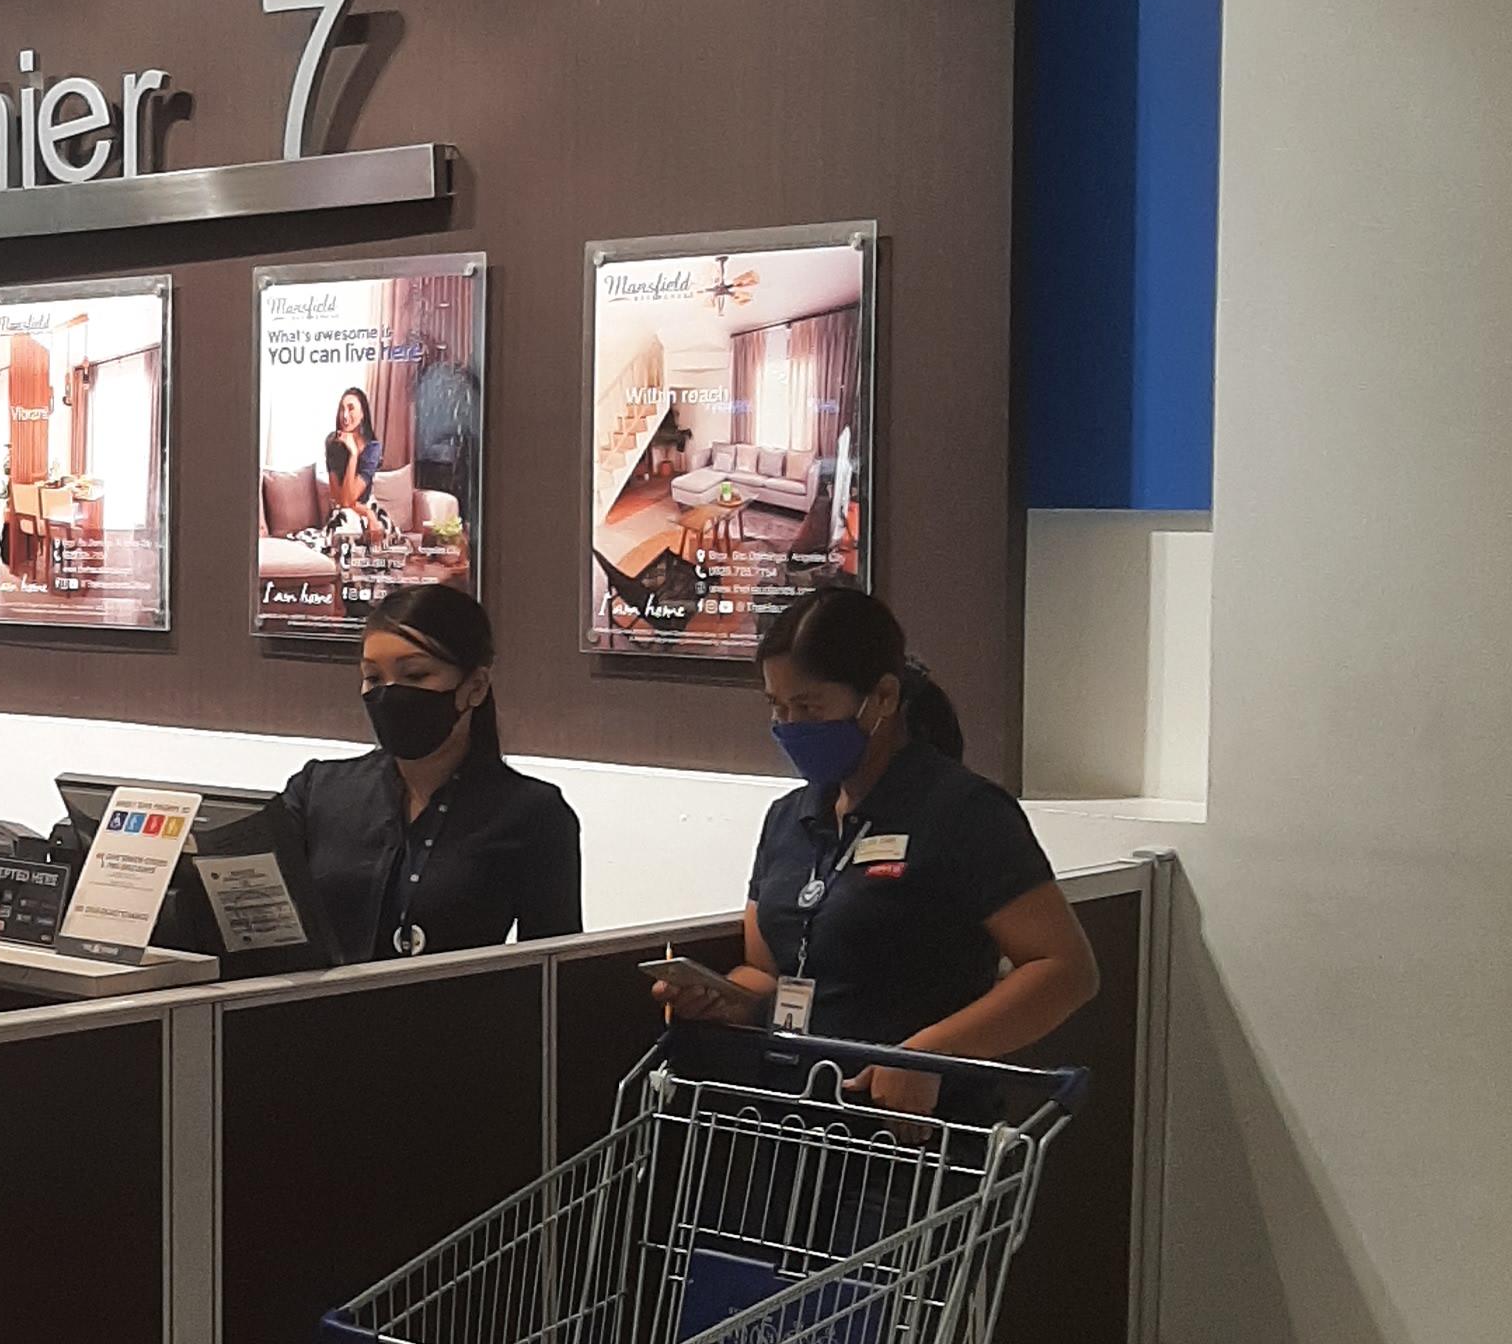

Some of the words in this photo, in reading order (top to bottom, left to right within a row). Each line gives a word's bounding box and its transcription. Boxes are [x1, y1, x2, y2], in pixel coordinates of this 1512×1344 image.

[604, 271, 692, 296] Mansfield
[268, 329, 311, 344] What's
[314, 327, 378, 342] awesome
[268, 345, 305, 366] YOU
[310, 347, 341, 364] can
[345, 342, 377, 363] live
[645, 593, 686, 619] home
